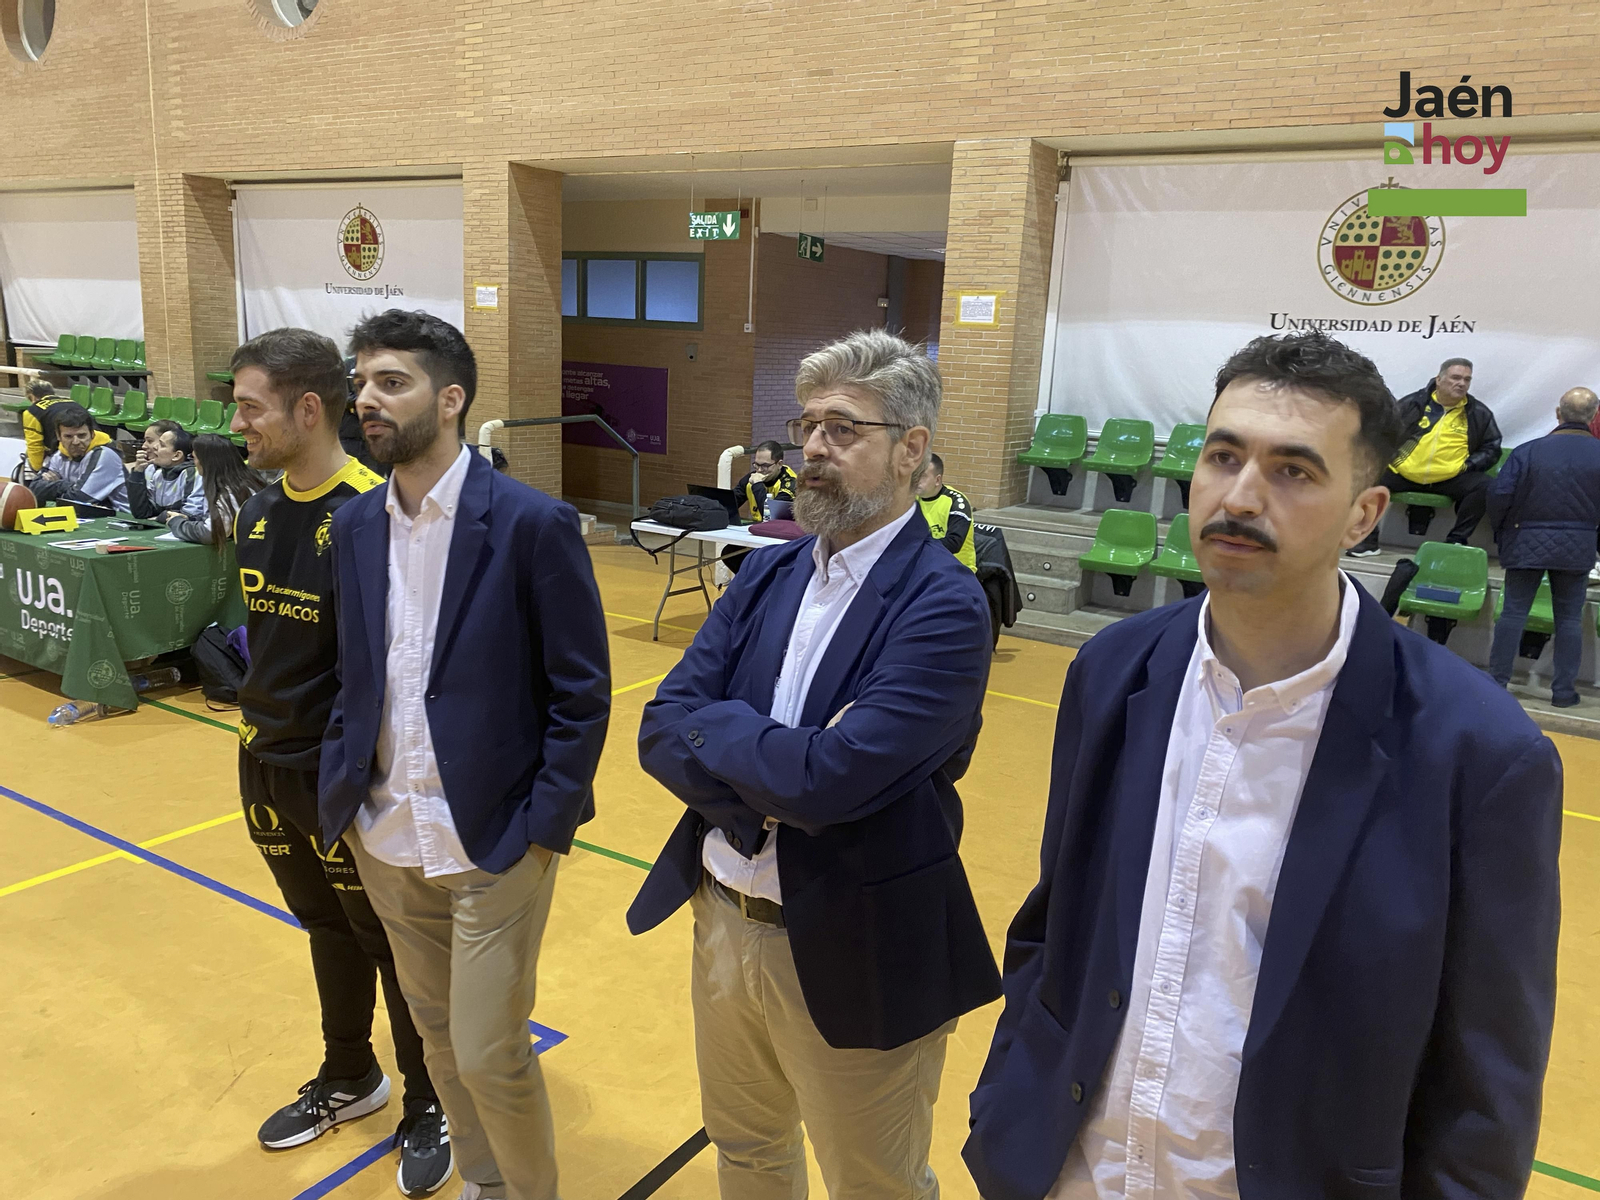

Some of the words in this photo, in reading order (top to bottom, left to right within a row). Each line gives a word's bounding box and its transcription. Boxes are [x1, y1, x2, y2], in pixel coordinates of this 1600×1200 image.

[691, 214, 717, 225] SALIDA
[690, 228, 718, 238] EXIT
[1323, 264, 1431, 302] GIENNENSIS
[584, 376, 611, 389] altas,
[250, 598, 276, 613] LOS
